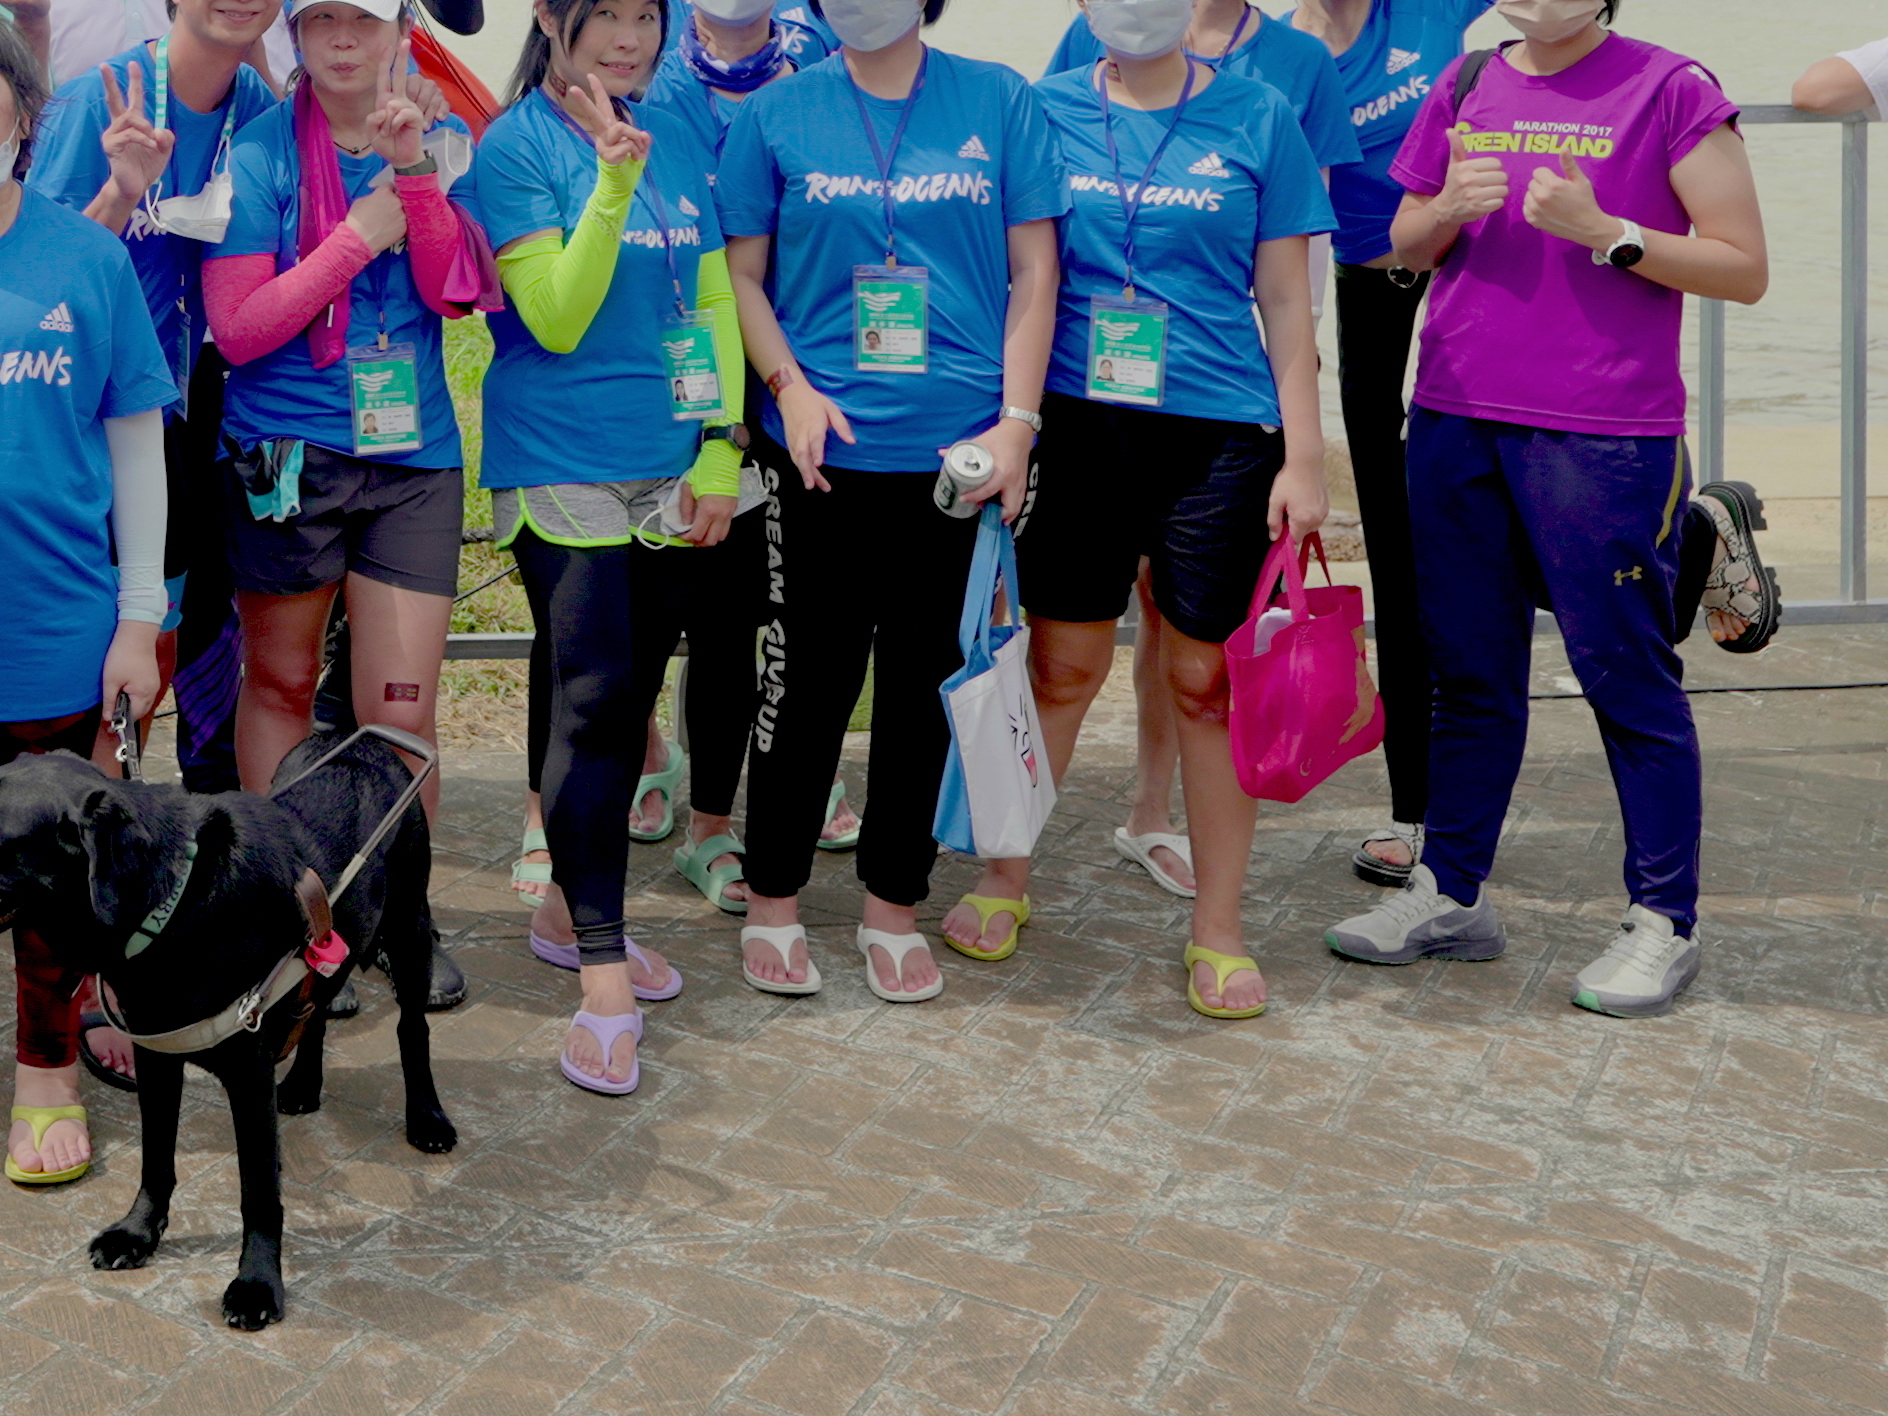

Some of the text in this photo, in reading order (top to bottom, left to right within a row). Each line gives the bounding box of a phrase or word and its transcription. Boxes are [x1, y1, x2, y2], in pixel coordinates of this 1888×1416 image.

[1353, 74, 1431, 126] OCEANS
[1513, 120, 1613, 136] MARATHON 2017
[1523, 133, 1614, 159] ISLAND
[1188, 166, 1230, 178] adidas
[805, 171, 873, 204] RUN
[895, 171, 993, 205] OCEANS
[1070, 175, 1109, 192] UN
